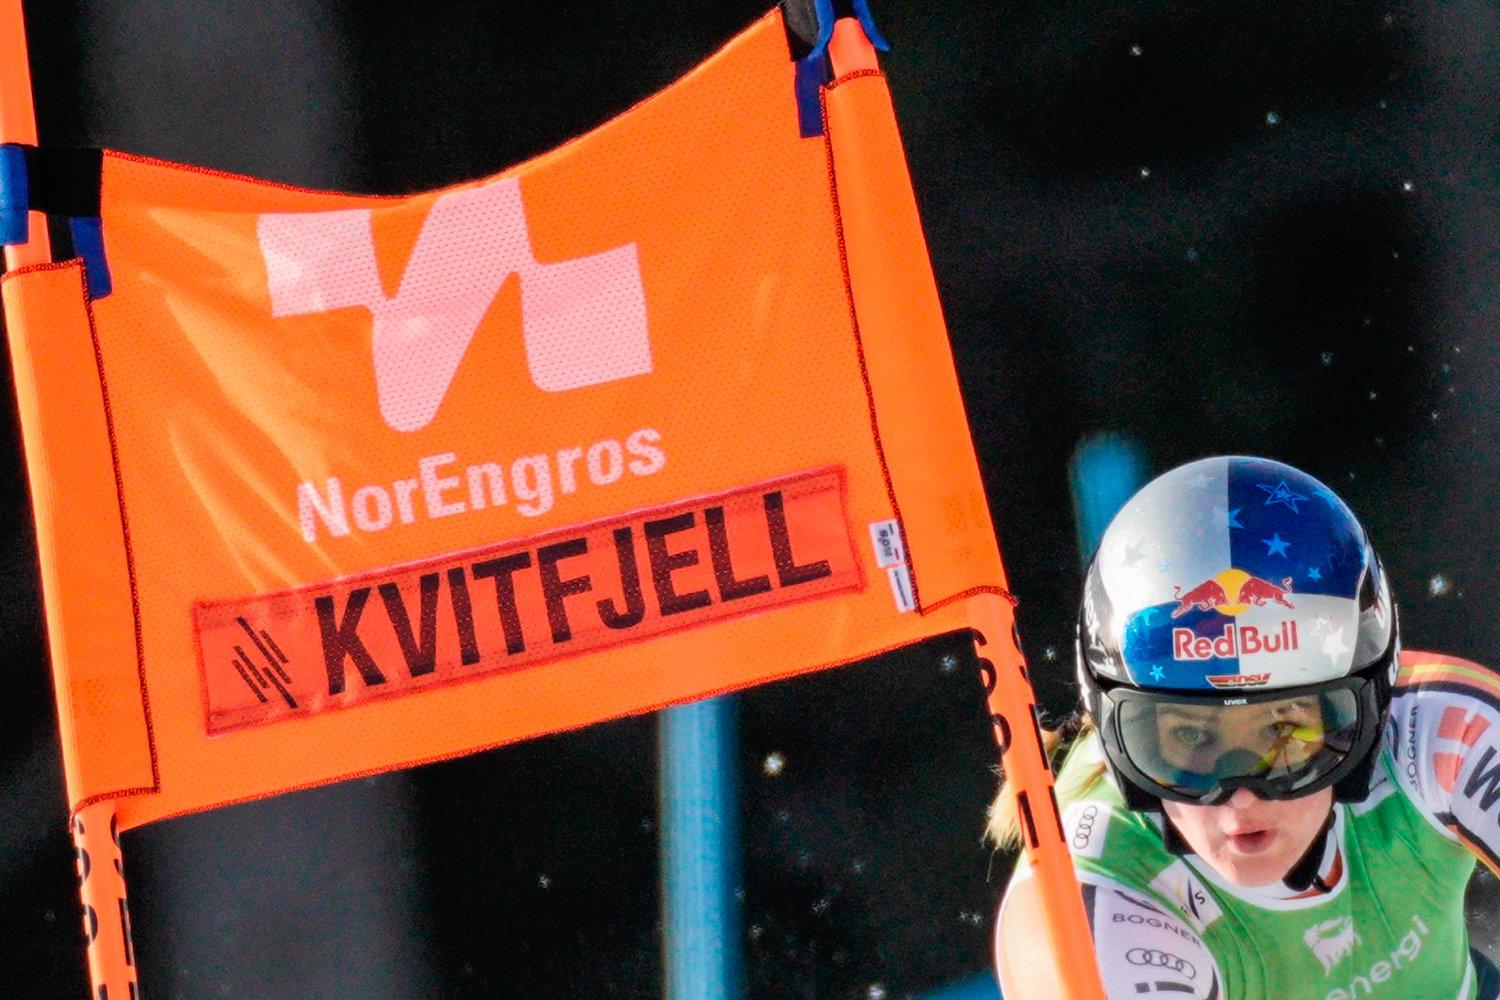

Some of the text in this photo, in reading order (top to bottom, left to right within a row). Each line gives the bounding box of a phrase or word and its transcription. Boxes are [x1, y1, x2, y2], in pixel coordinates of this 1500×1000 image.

[298, 427, 666, 541] NorEngros
[316, 492, 831, 695] KVITFJELL
[1173, 621, 1299, 661] Red Bull
[1112, 912, 1202, 946] BOGNER
